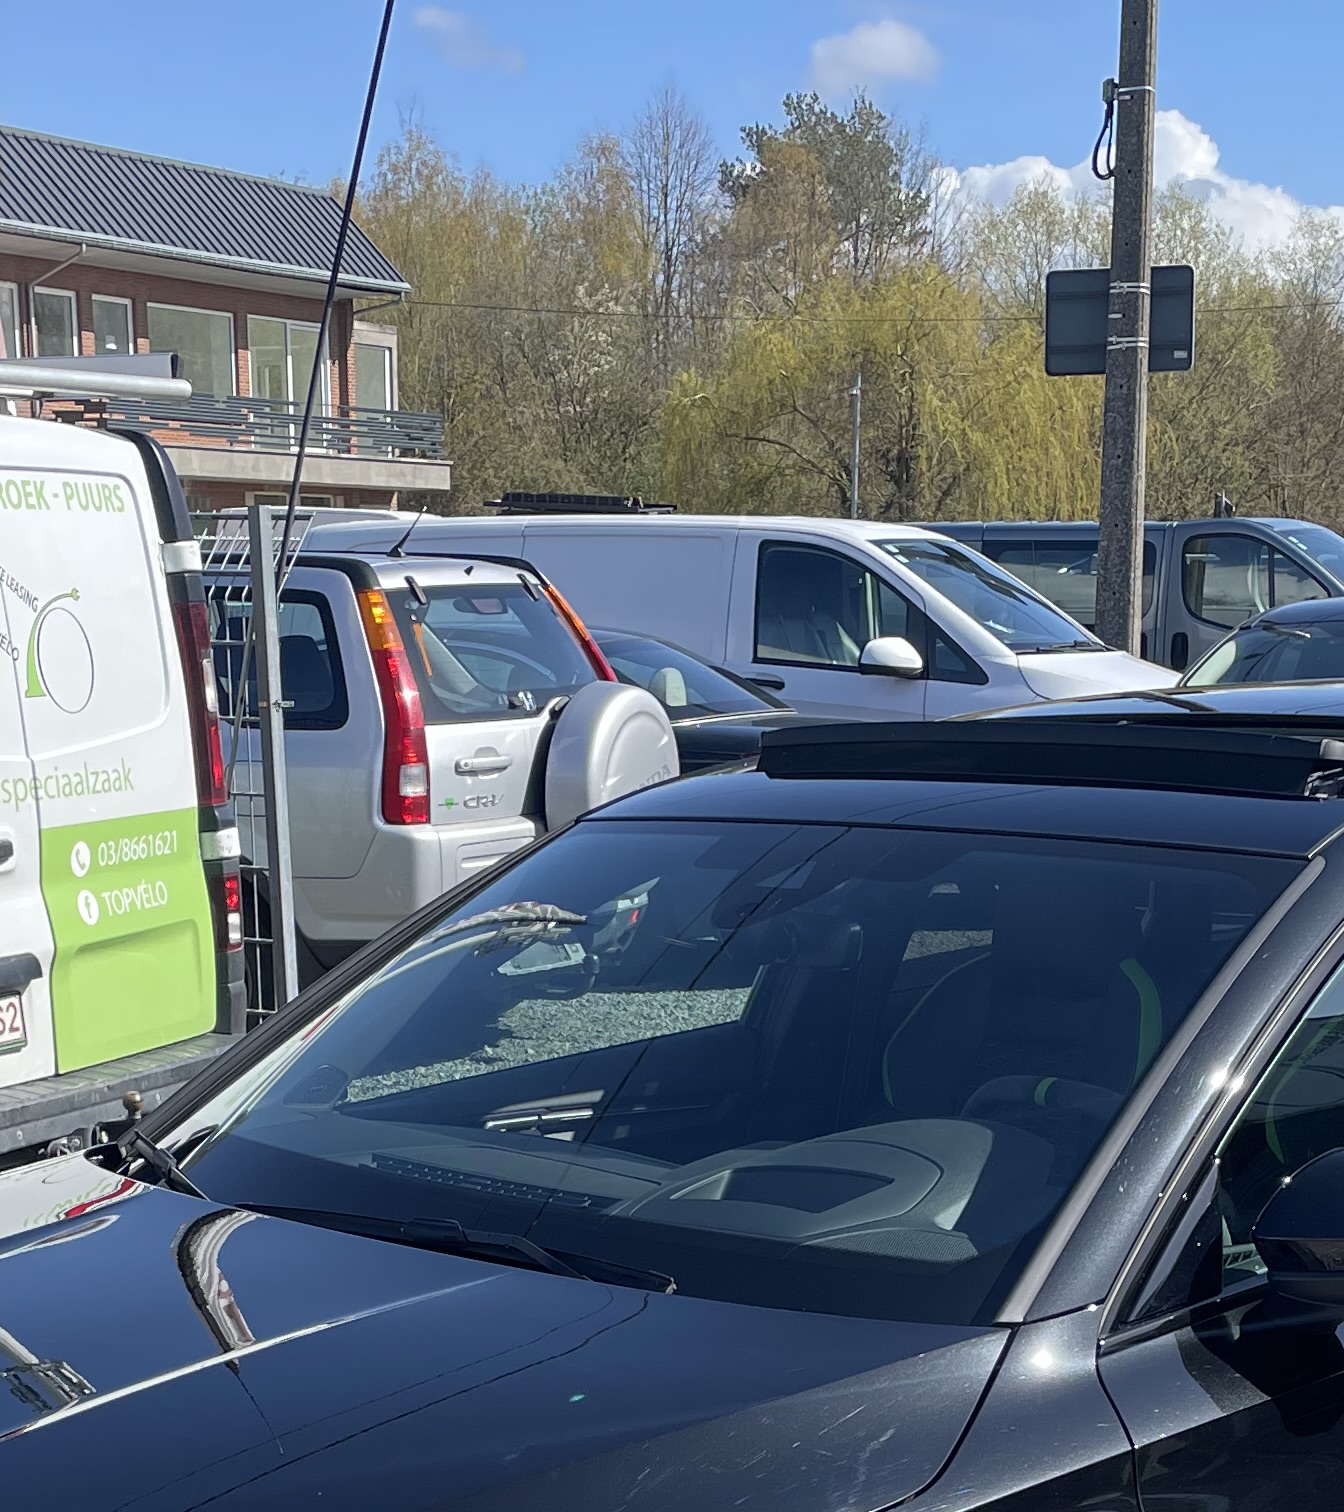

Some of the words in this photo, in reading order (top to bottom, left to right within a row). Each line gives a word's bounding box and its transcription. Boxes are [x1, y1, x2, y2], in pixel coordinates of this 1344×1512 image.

[62, 481, 126, 513] PUURS
[5, 574, 40, 613] LEASING
[1, 758, 135, 812] speciaalzaak
[98, 830, 179, 867] 03/8661621
[101, 880, 169, 918] TOPVÉLO
